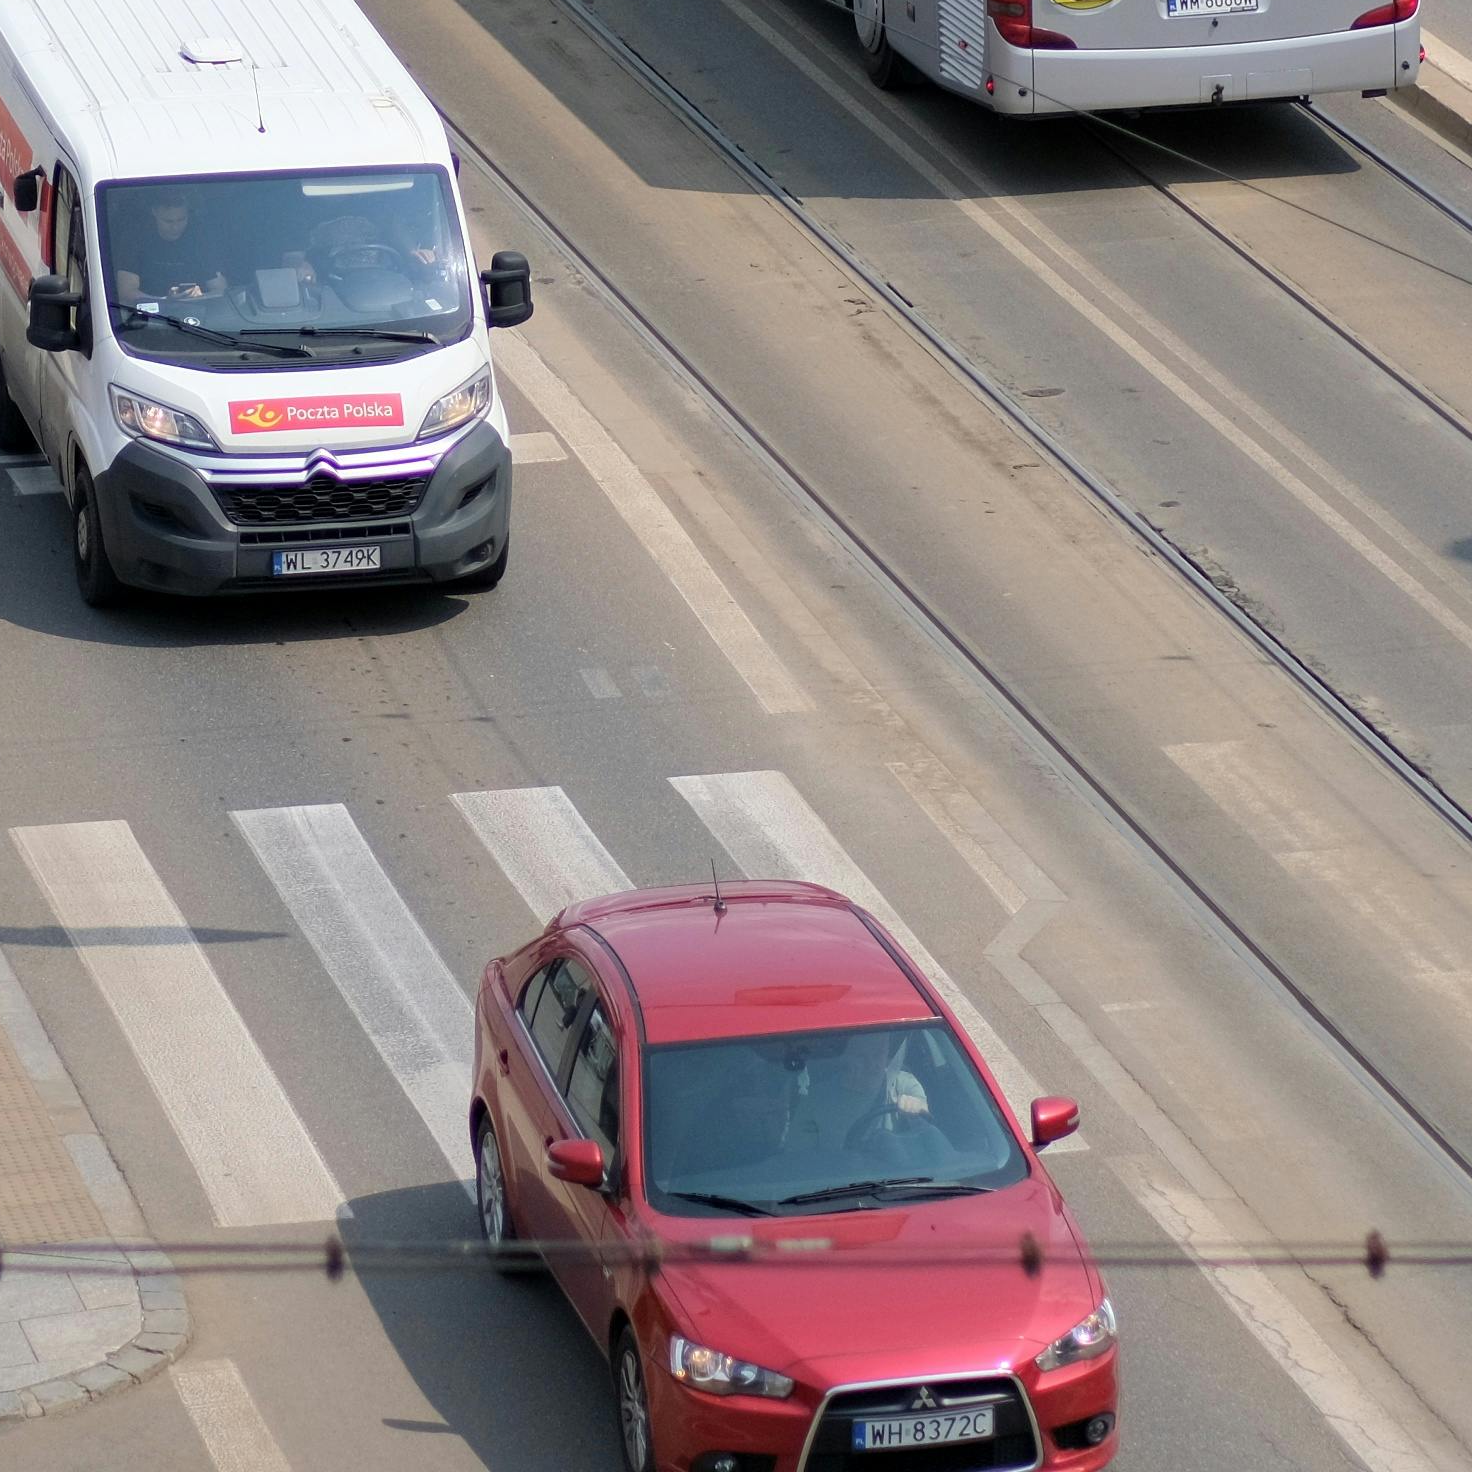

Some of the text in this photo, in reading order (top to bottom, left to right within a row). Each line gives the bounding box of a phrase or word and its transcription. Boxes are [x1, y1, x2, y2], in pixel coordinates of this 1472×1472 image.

[287, 401, 393, 421] Poczta Polska
[285, 548, 378, 571] WL 3749K
[872, 1413, 987, 1446] WH 8372C
